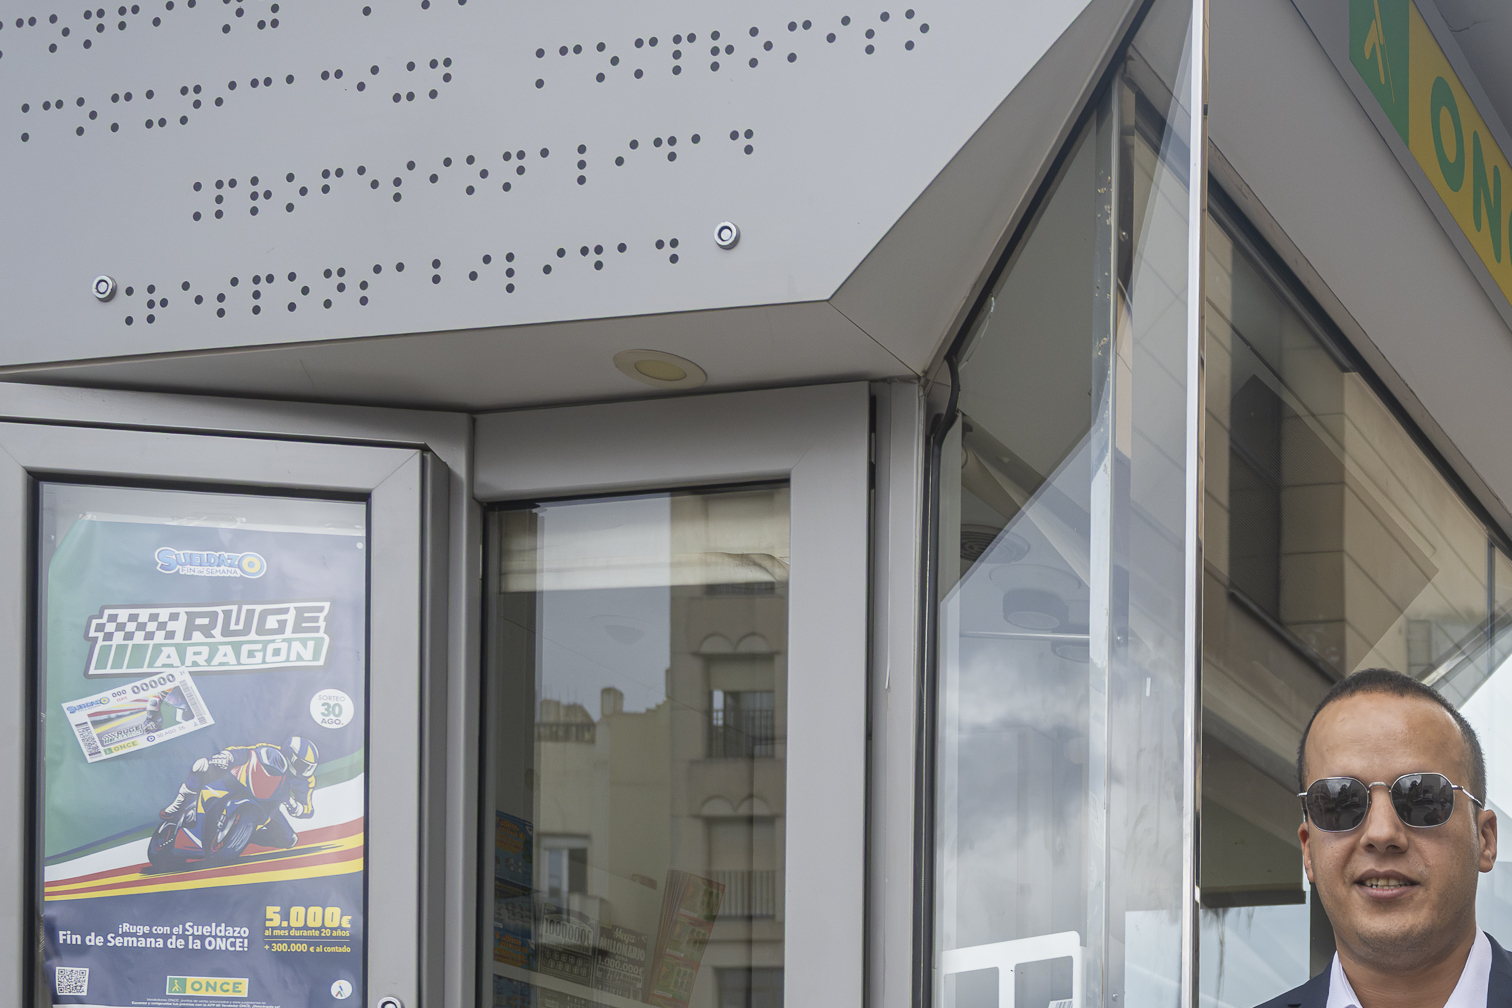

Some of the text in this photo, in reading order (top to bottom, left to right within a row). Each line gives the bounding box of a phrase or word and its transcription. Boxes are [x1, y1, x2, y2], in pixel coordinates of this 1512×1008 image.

[156, 548, 267, 578] SUELDAZO
[181, 566, 196, 574] FIN
[206, 568, 239, 576] SEMANA
[183, 603, 328, 641] RUGE
[153, 638, 315, 668] ARAGÓN
[111, 688, 128, 698] 000
[130, 672, 176, 695] 00000
[318, 694, 346, 702] SORTEO
[320, 702, 343, 718] 30
[321, 718, 344, 726] AGO.
[113, 740, 138, 752] ONCE
[265, 906, 352, 928] 5.000€
[118, 922, 250, 938] ¡Ruge con el Sueldazo
[264, 928, 272, 936] al
[290, 928, 320, 936] durante
[320, 928, 331, 936] 20
[332, 929, 350, 937] años
[58, 930, 250, 952] Fin de Semana de la ONCE!
[271, 942, 308, 952] 300.000
[316, 945, 322, 953] al
[324, 945, 352, 953] contado
[190, 980, 243, 994] ONCE
